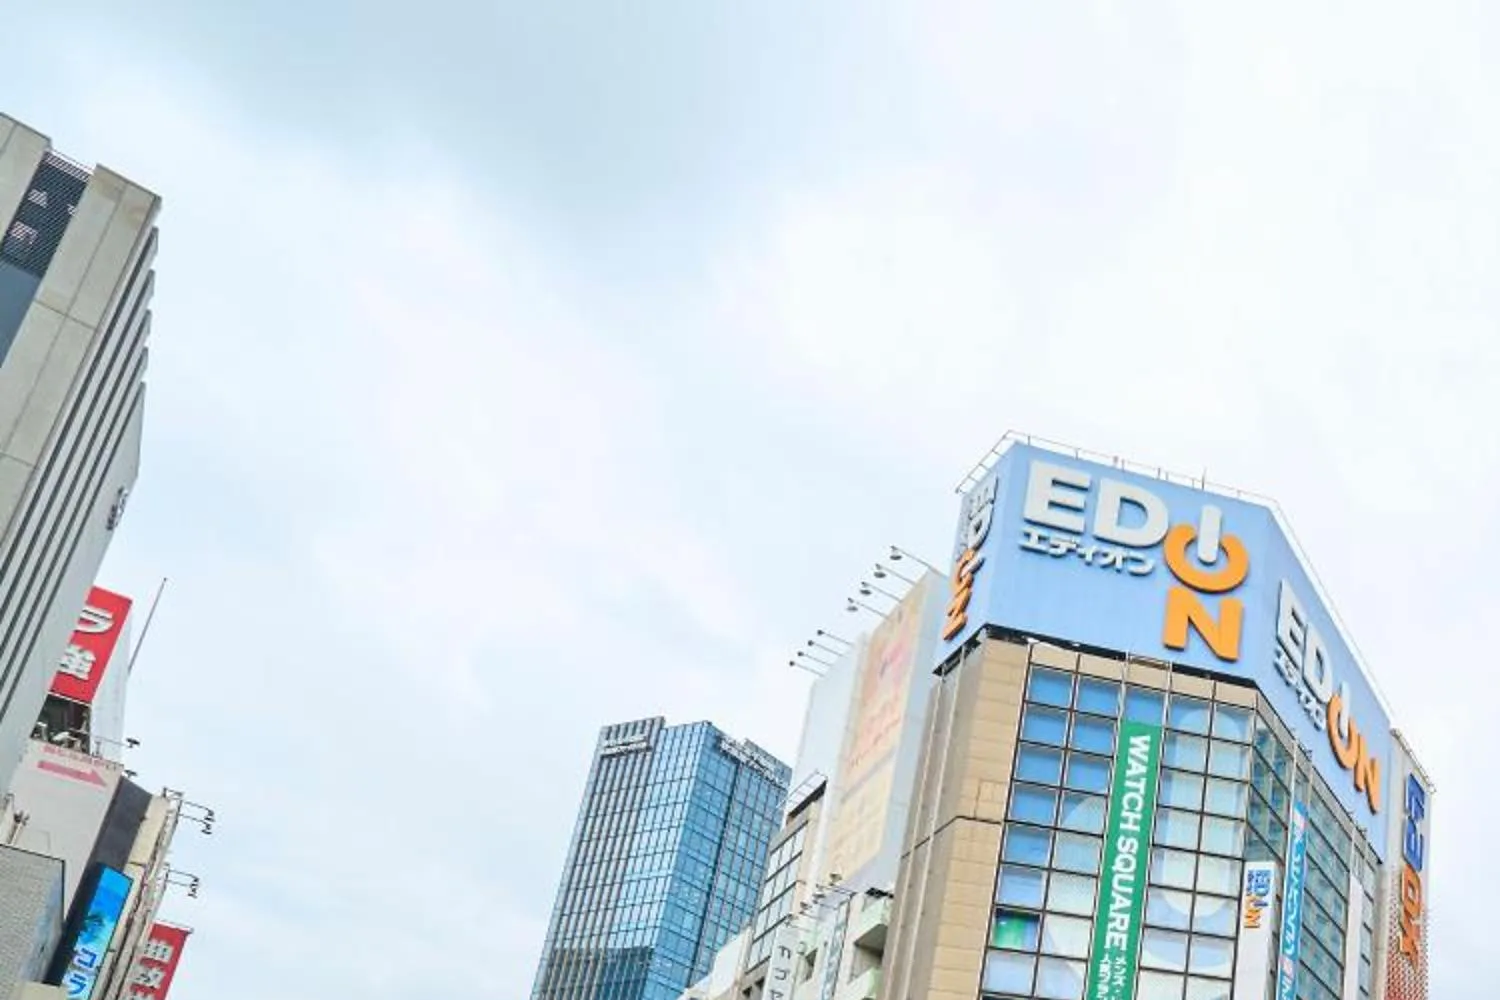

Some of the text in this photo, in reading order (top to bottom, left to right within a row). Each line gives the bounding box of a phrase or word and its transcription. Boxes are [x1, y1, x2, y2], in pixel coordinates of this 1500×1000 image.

[1019, 527, 1156, 577] エディオン
[1022, 460, 1249, 662] EDION
[1276, 579, 1382, 815] EDION
[1104, 735, 1150, 951] WATCH SQUARE
